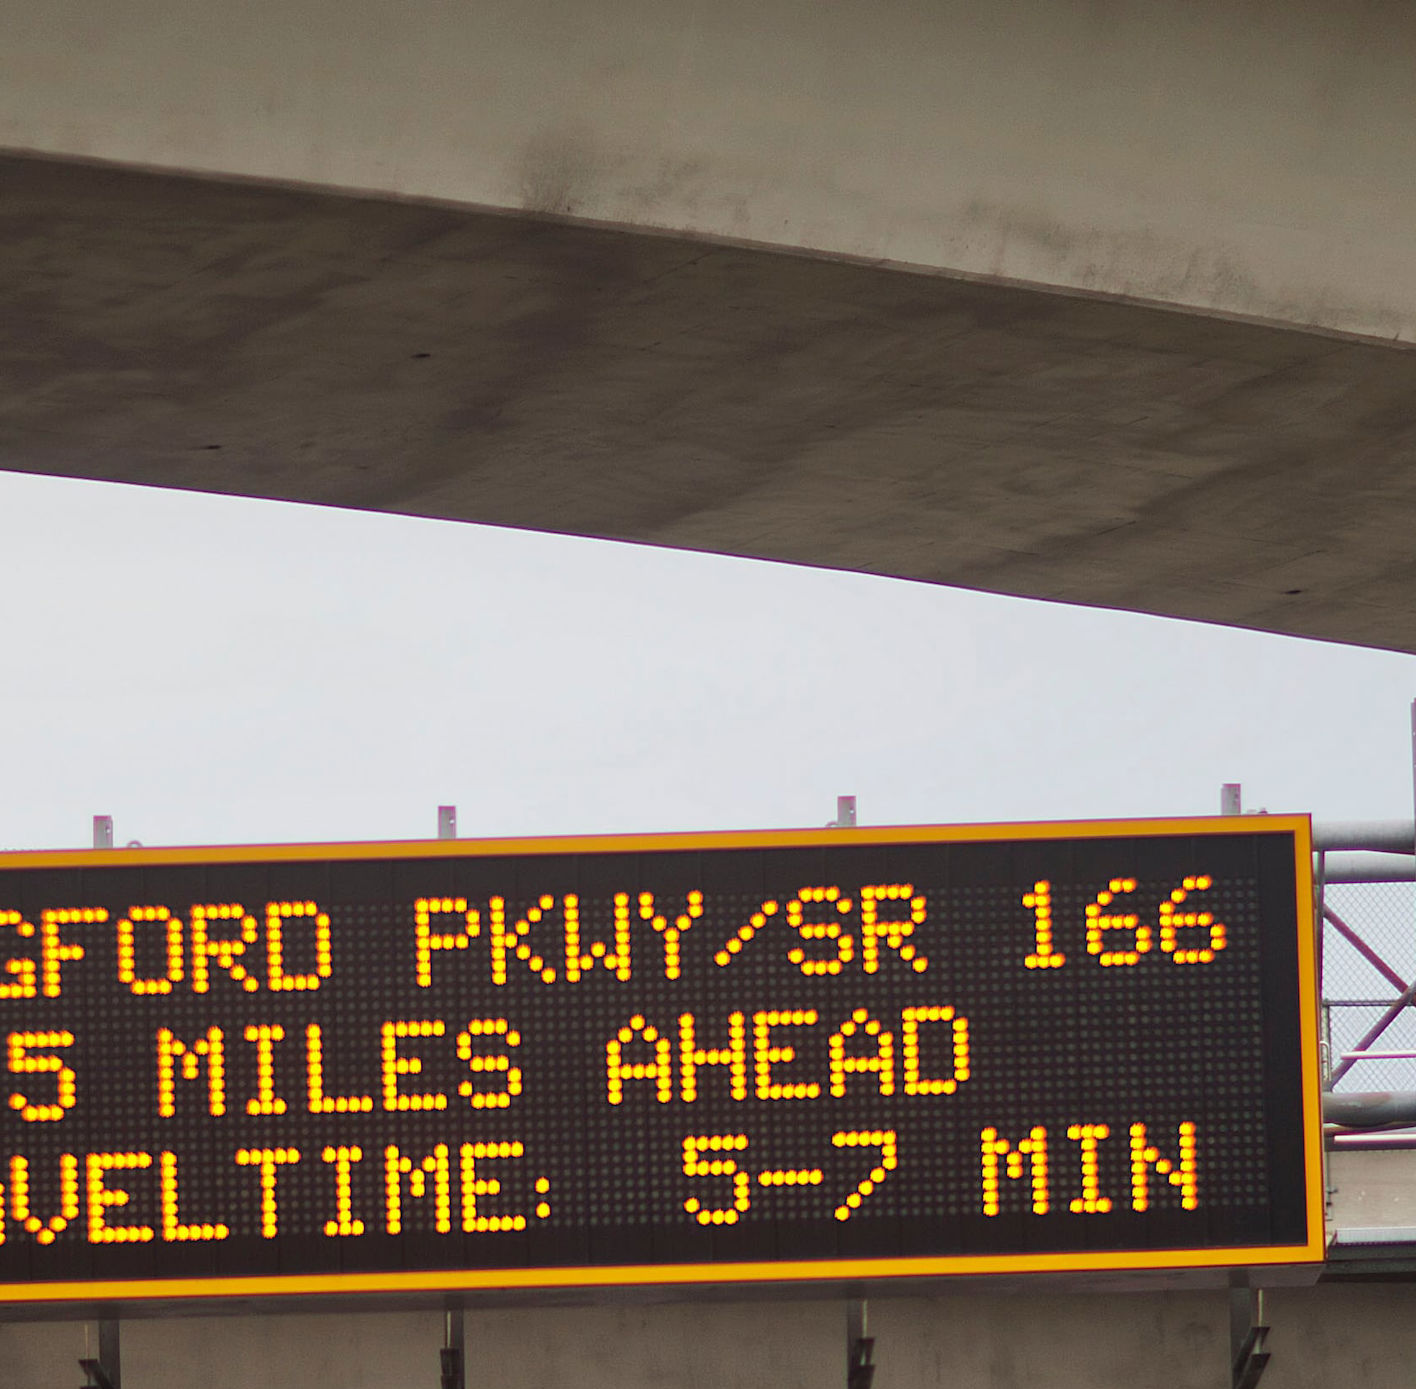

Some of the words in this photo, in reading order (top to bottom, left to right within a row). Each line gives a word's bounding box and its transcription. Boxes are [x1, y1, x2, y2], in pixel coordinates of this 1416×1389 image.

[415, 884, 929, 986] PKWY/SR
[1022, 876, 1227, 968] 166
[7, 1030, 76, 1121] 5
[157, 1019, 523, 1117] MILES
[606, 1005, 971, 1104] AHEAD
[682, 1131, 898, 1224] 5-7
[981, 1122, 1197, 1216] MIN
